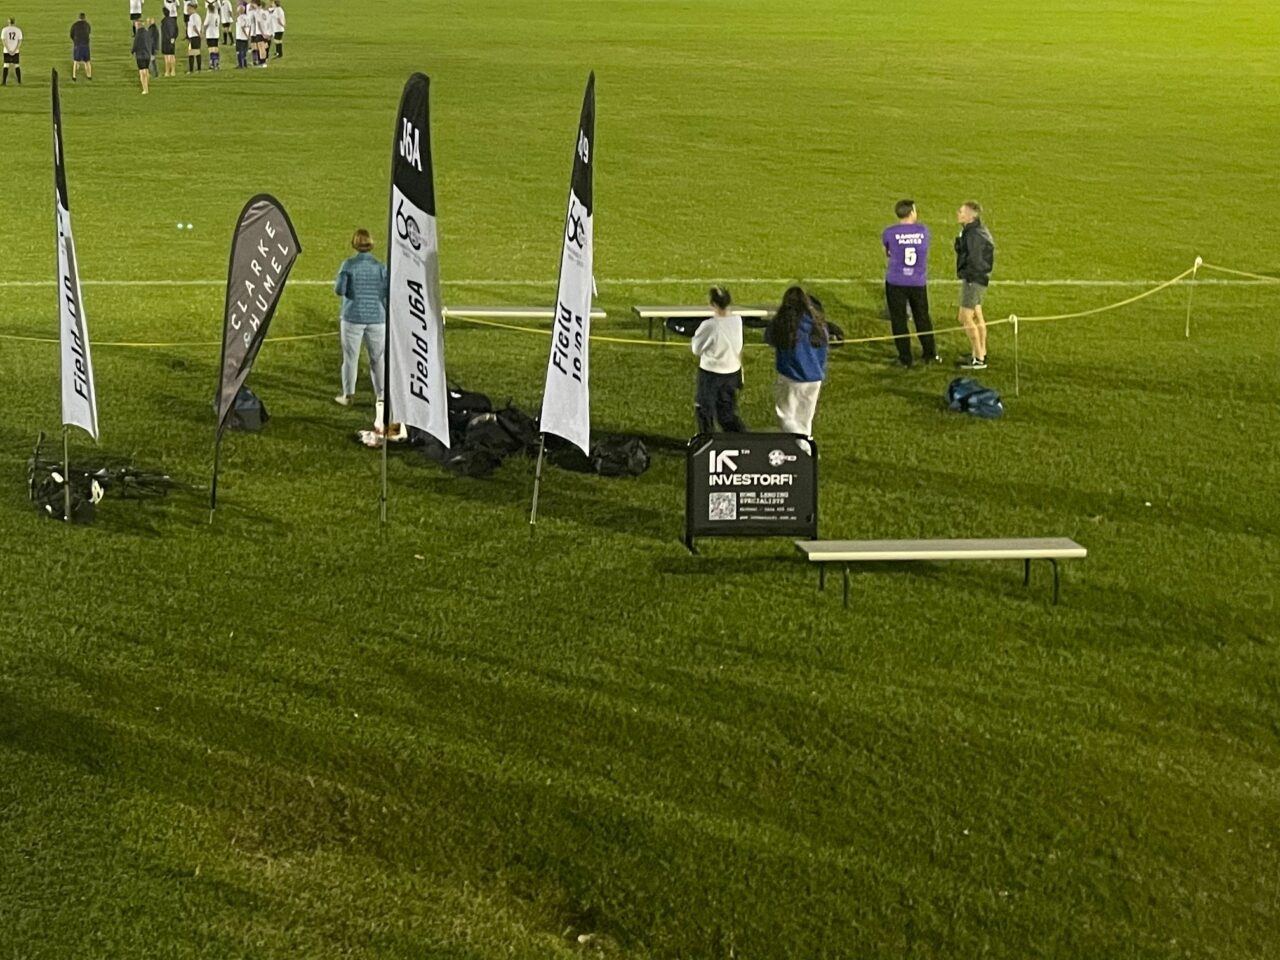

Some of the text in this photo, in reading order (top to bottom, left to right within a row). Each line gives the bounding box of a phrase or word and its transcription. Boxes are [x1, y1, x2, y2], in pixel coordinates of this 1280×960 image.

[8, 31, 16, 40] 12
[400, 117, 422, 172] J6A
[231, 221, 276, 330] CLARKE
[904, 247, 917, 266] 5
[250, 243, 289, 332] HUMEL
[406, 279, 427, 331] J6A
[410, 331, 430, 404] Field
[709, 473, 793, 486] INVESTORFI
